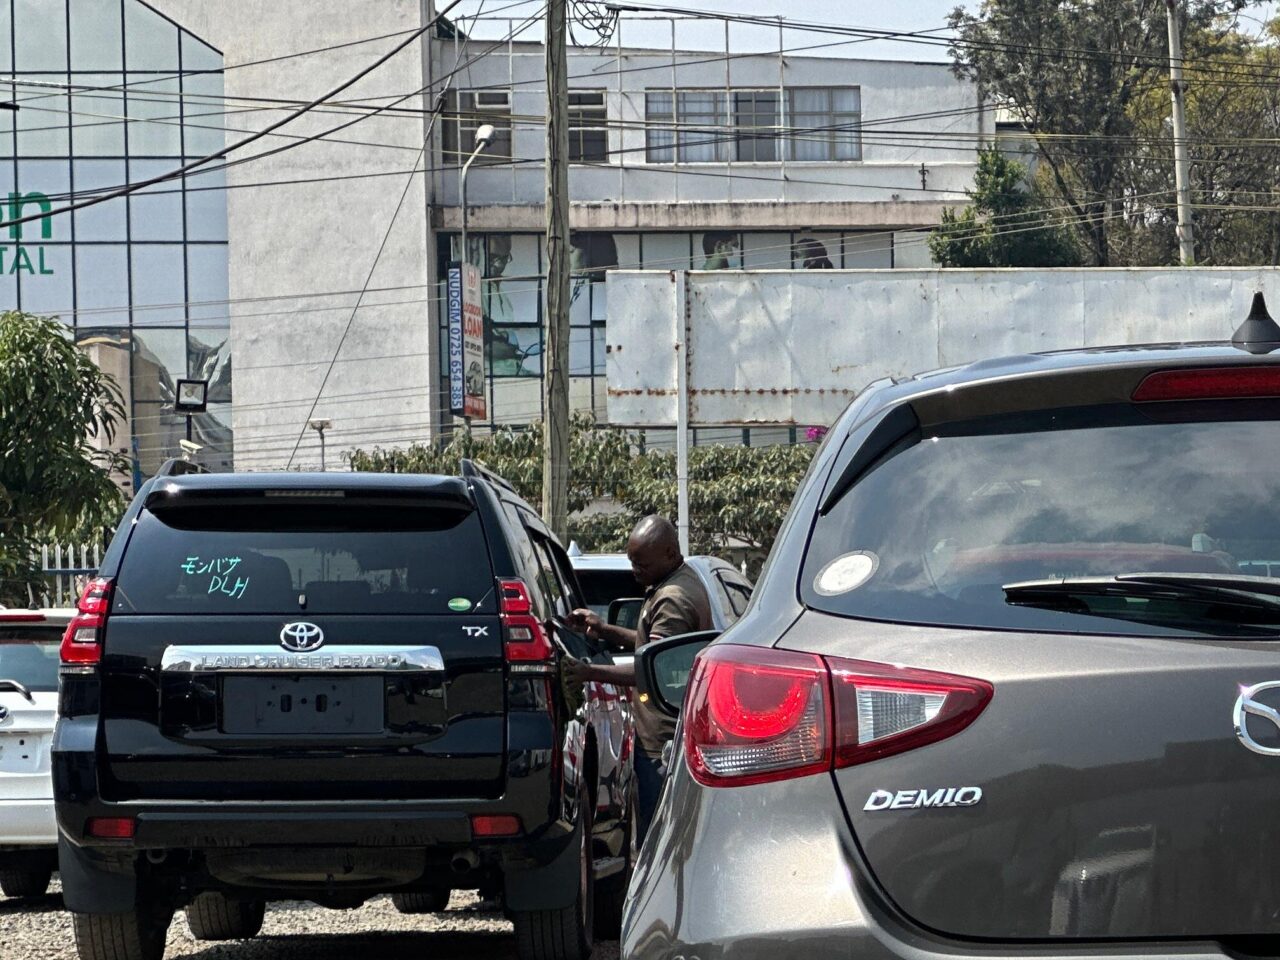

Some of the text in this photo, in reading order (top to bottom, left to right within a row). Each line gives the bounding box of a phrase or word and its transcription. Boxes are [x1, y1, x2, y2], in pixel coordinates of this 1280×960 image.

[0, 191, 52, 239] n
[450, 270, 463, 407] NUDGIM 0725 654 385
[464, 316, 482, 338] LOAN
[181, 556, 242, 576] モンバサ
[207, 575, 250, 599] DLH
[461, 626, 489, 637] TX
[201, 654, 401, 669] LAND CRUISER PRADO
[862, 786, 983, 811] DEMIO
